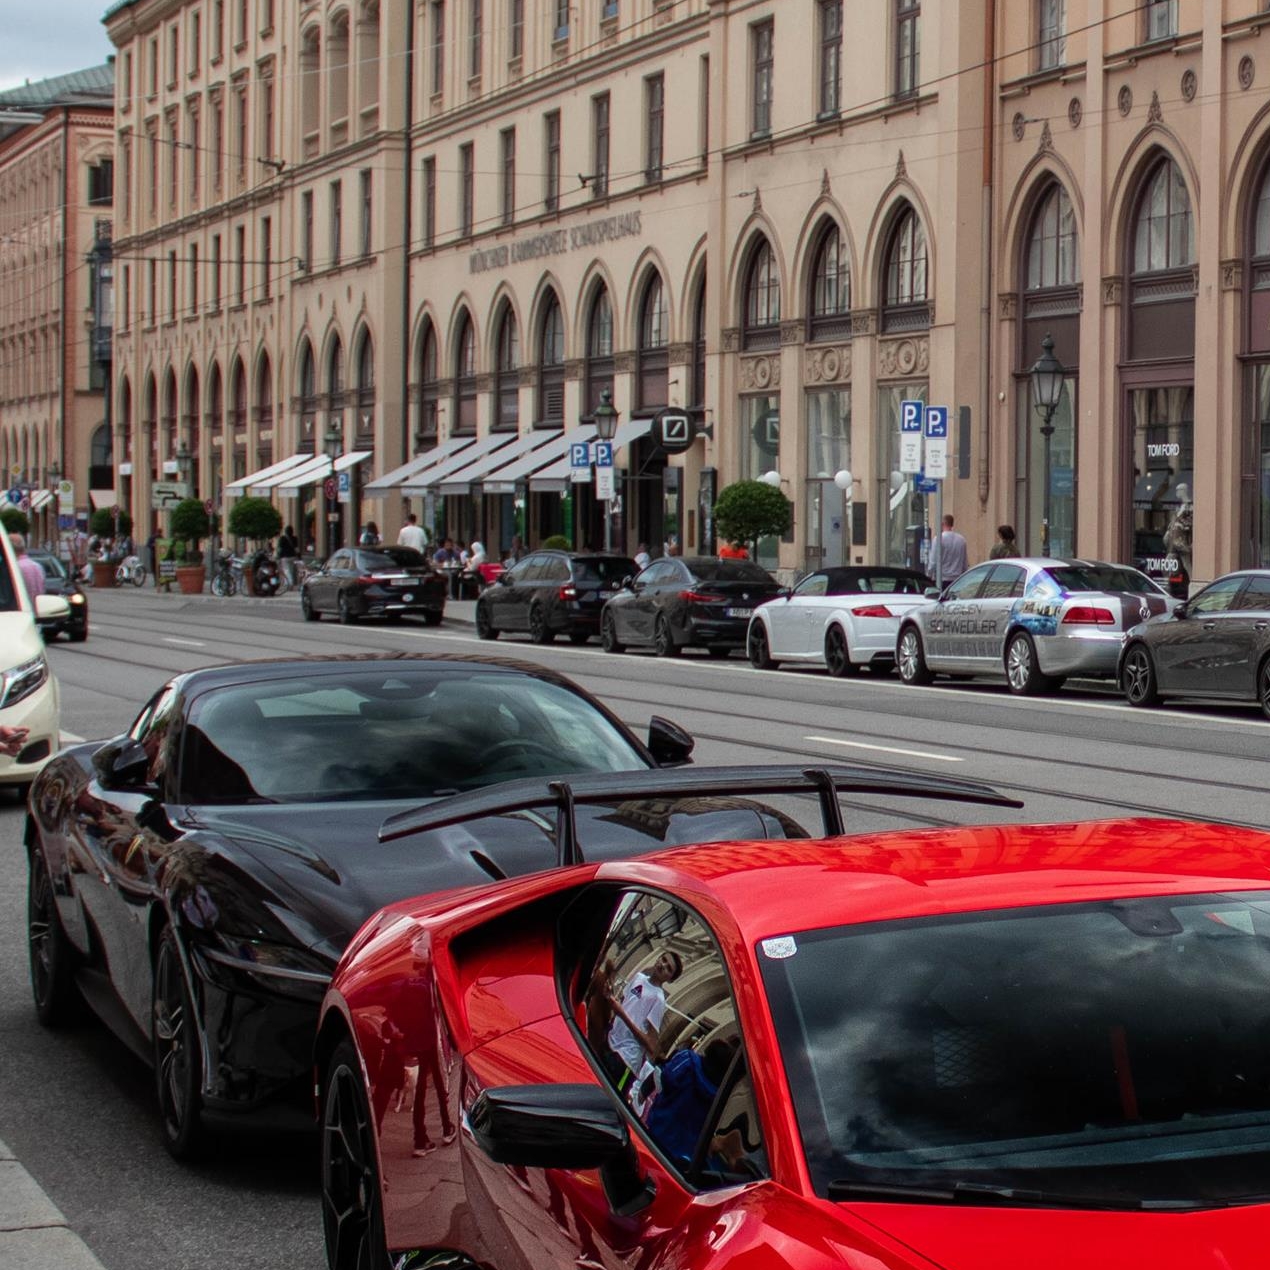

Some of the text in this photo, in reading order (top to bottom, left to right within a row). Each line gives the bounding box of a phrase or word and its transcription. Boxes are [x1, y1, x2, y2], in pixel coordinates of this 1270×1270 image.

[1147, 443, 1180, 457] TOM FORD
[1146, 558, 1179, 571] TOM FORD
[929, 620, 998, 634] SCHWEDLER
